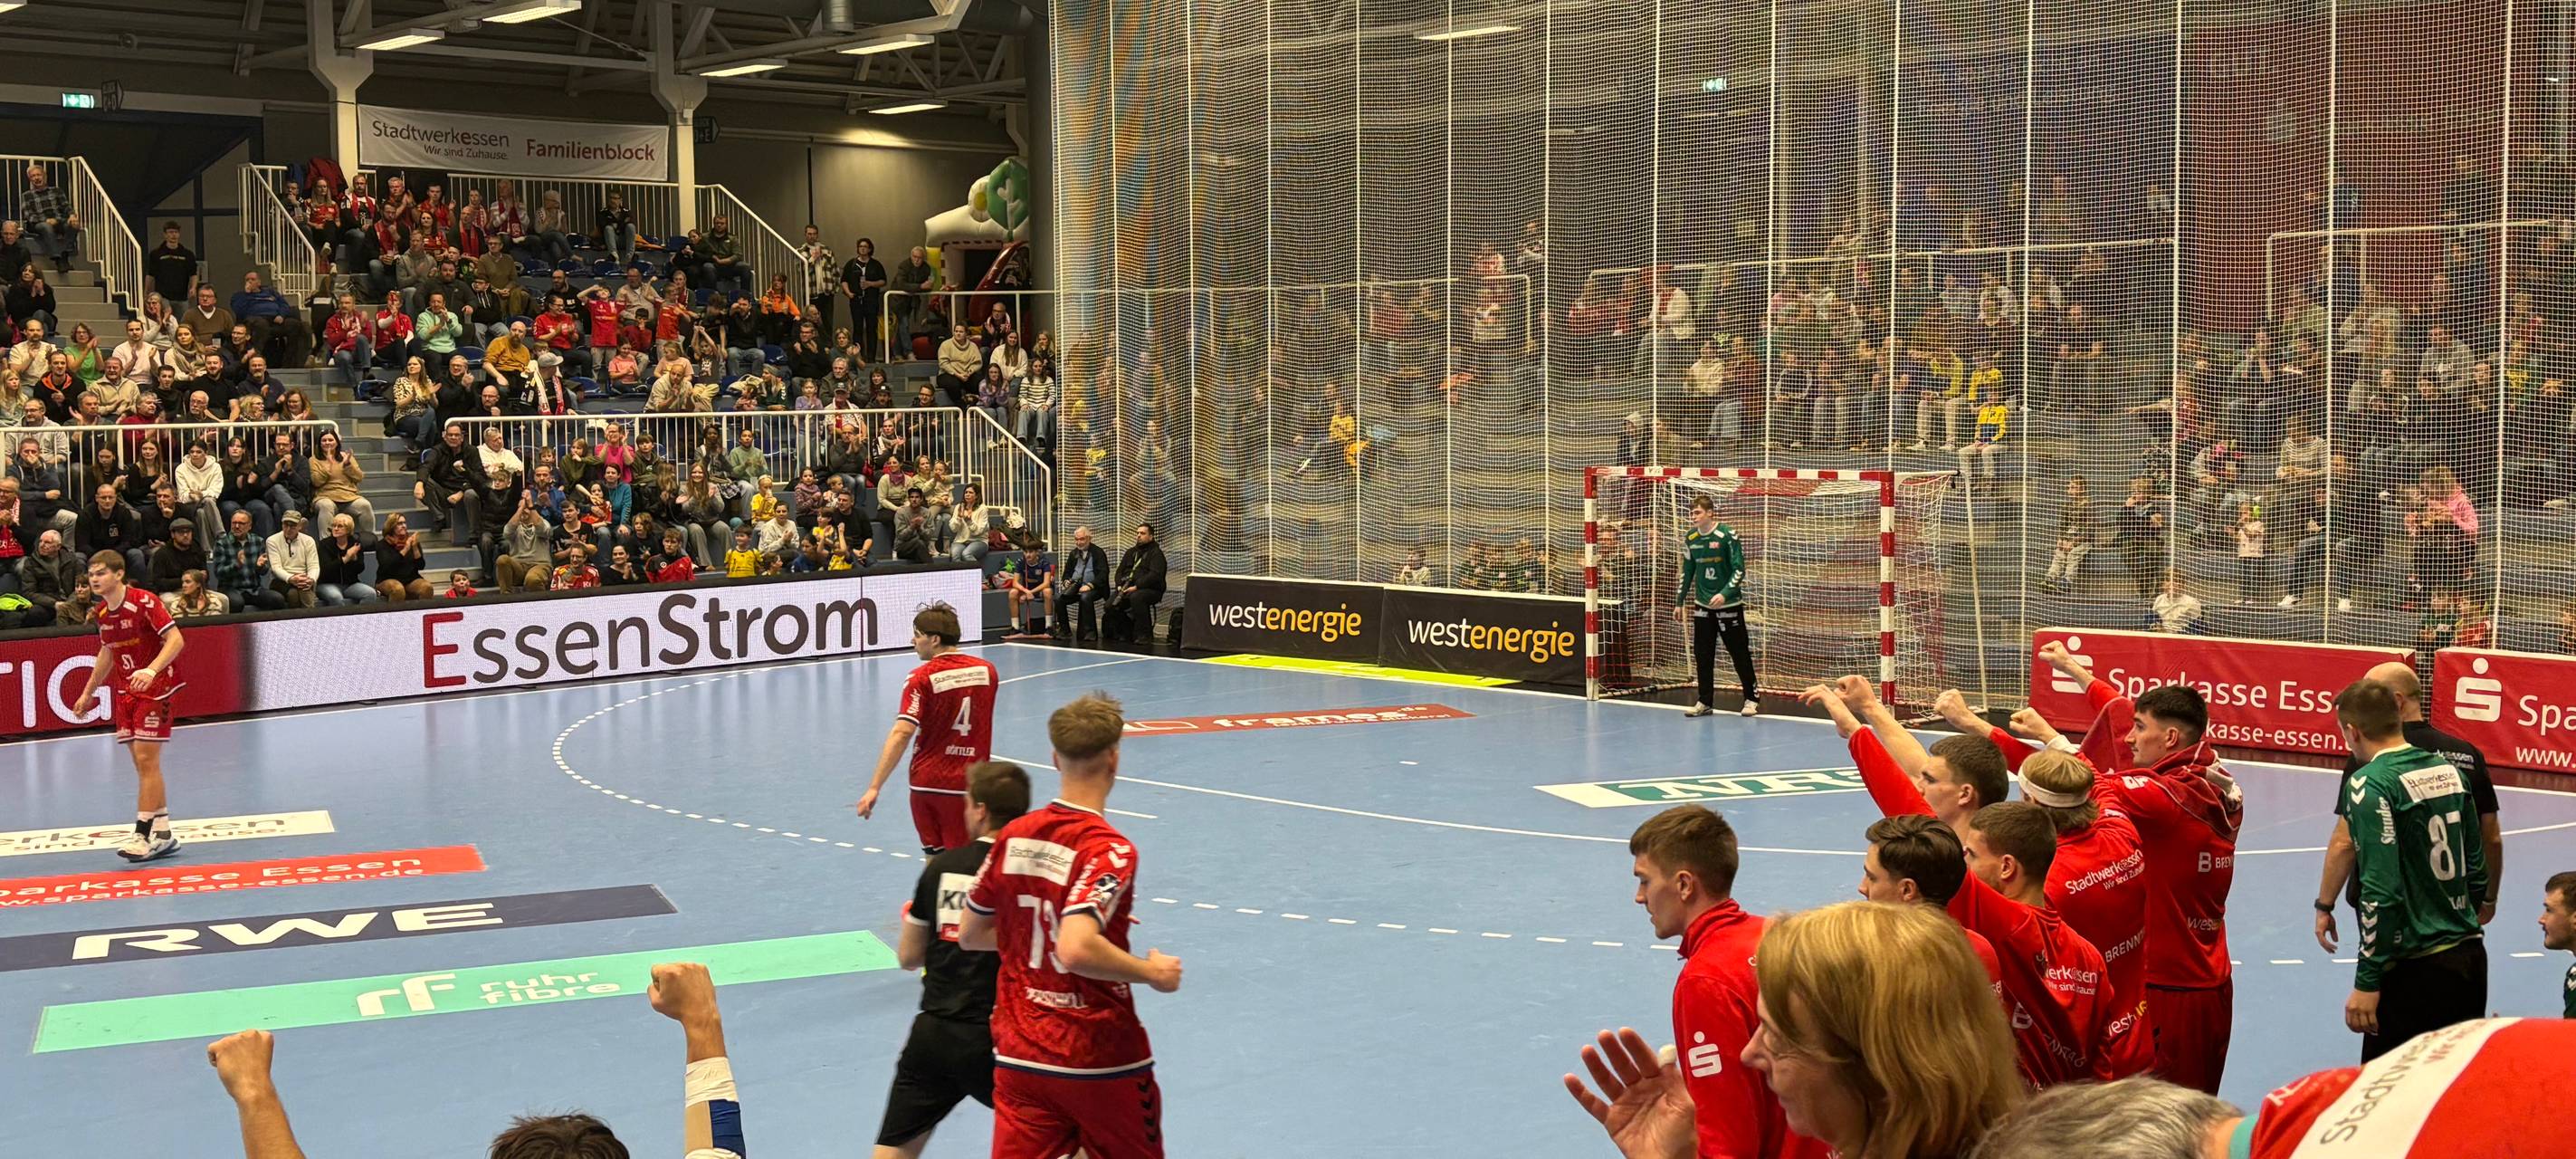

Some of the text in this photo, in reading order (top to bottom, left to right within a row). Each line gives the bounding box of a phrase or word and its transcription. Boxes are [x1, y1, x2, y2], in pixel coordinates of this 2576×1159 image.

[372, 120, 510, 148] Stadtwerkessen
[424, 144, 441, 155] Wir
[444, 147, 463, 158] sind
[526, 138, 655, 161] Familienblock
[423, 593, 878, 688] EssenStrom
[1209, 601, 1362, 643] westenergie
[1407, 618, 1576, 664] westenergie
[0, 655, 112, 728] IG
[2108, 667, 2335, 714] Spasse Ess
[951, 696, 972, 736] 4
[2205, 719, 2353, 752] kasse-essen.
[2376, 796, 2397, 845] Stauder
[2428, 810, 2466, 881] 87
[262, 858, 421, 878] Essen
[72, 902, 504, 960] RWE
[479, 971, 600, 991] ruhr
[480, 981, 622, 1005] fibre
